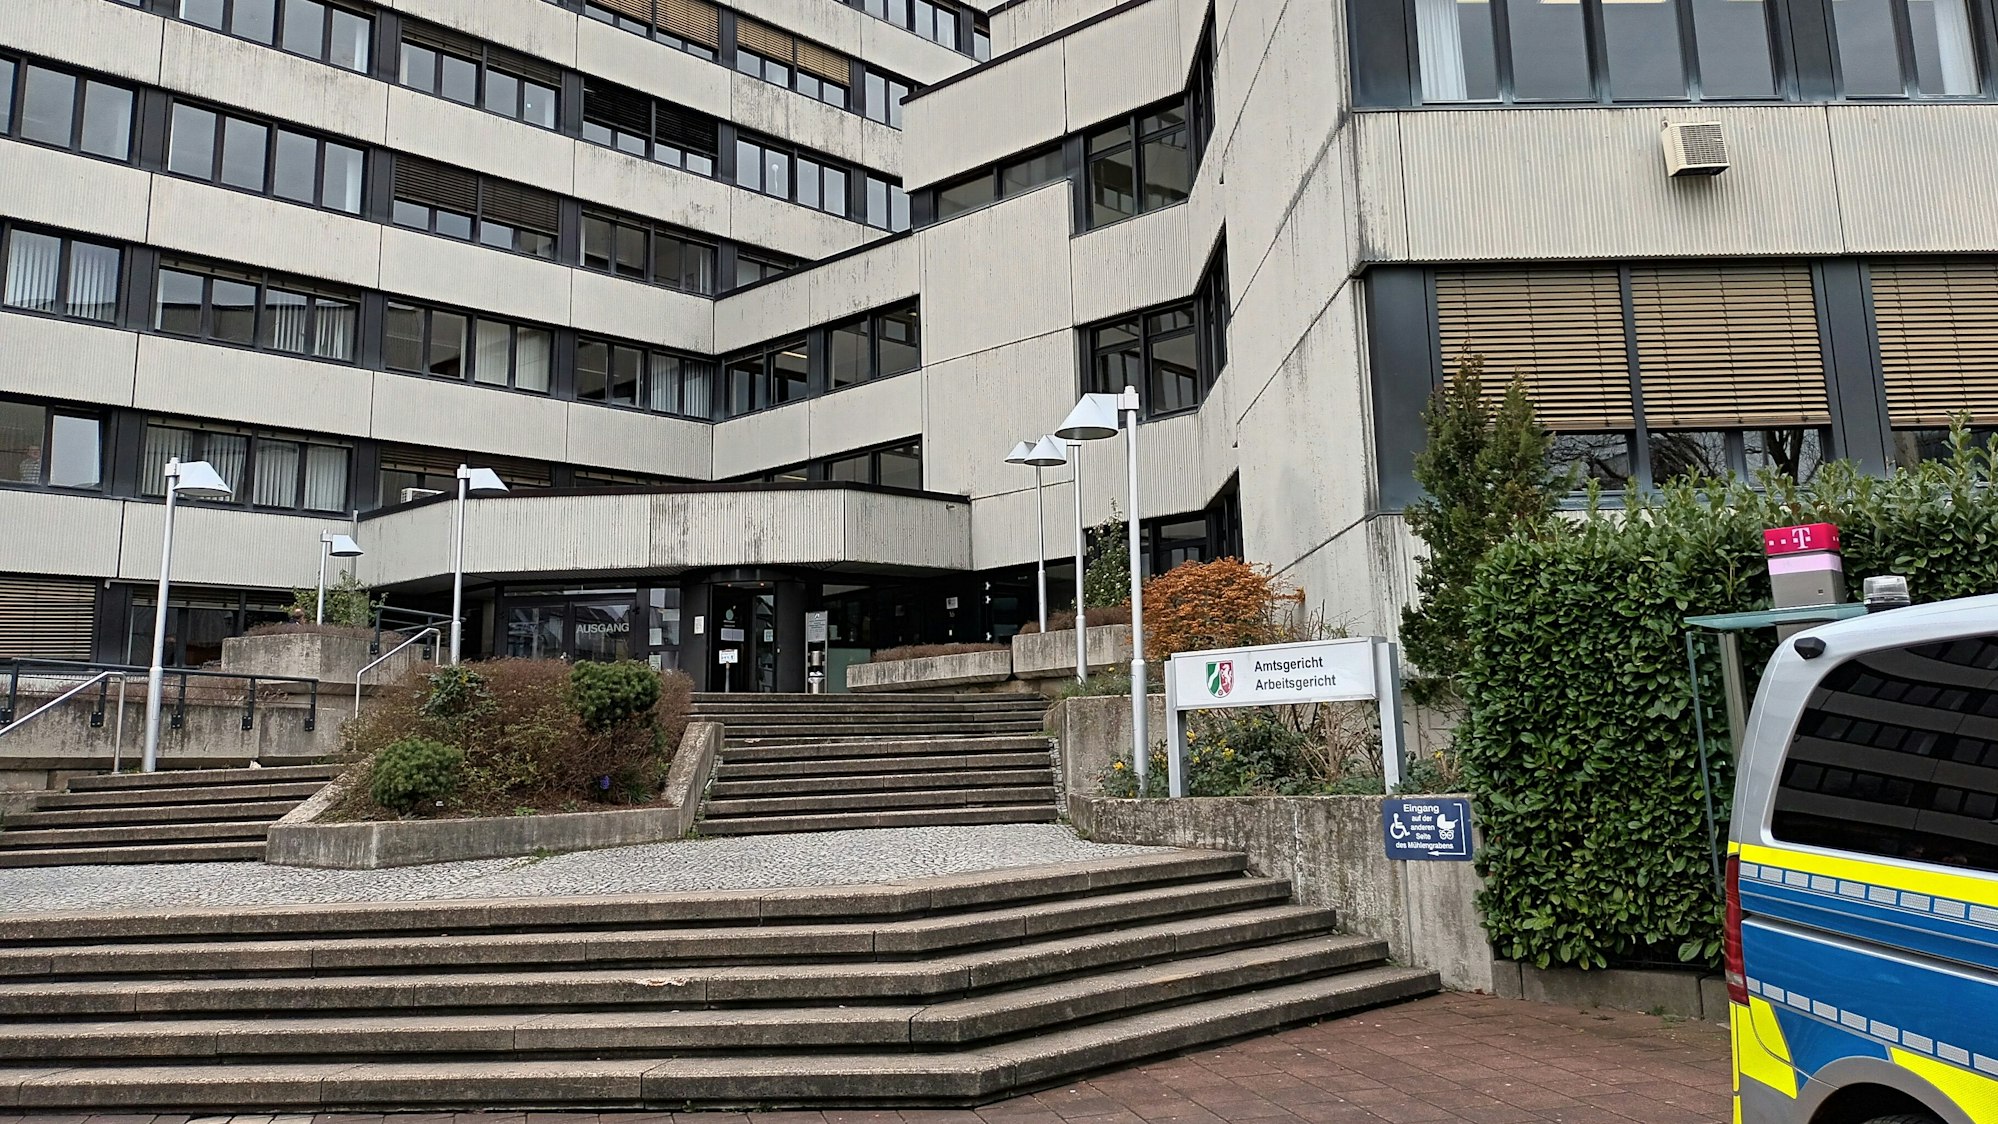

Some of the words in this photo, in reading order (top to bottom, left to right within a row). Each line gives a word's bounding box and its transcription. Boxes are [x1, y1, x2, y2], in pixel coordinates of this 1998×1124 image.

[575, 623, 630, 634] AUSGANG
[1254, 656, 1323, 673] Amtsgericht
[1255, 674, 1336, 691] Arbeitsgericht
[1403, 804, 1440, 814] Eingang
[1407, 842, 1454, 850] Mühlengrabens
